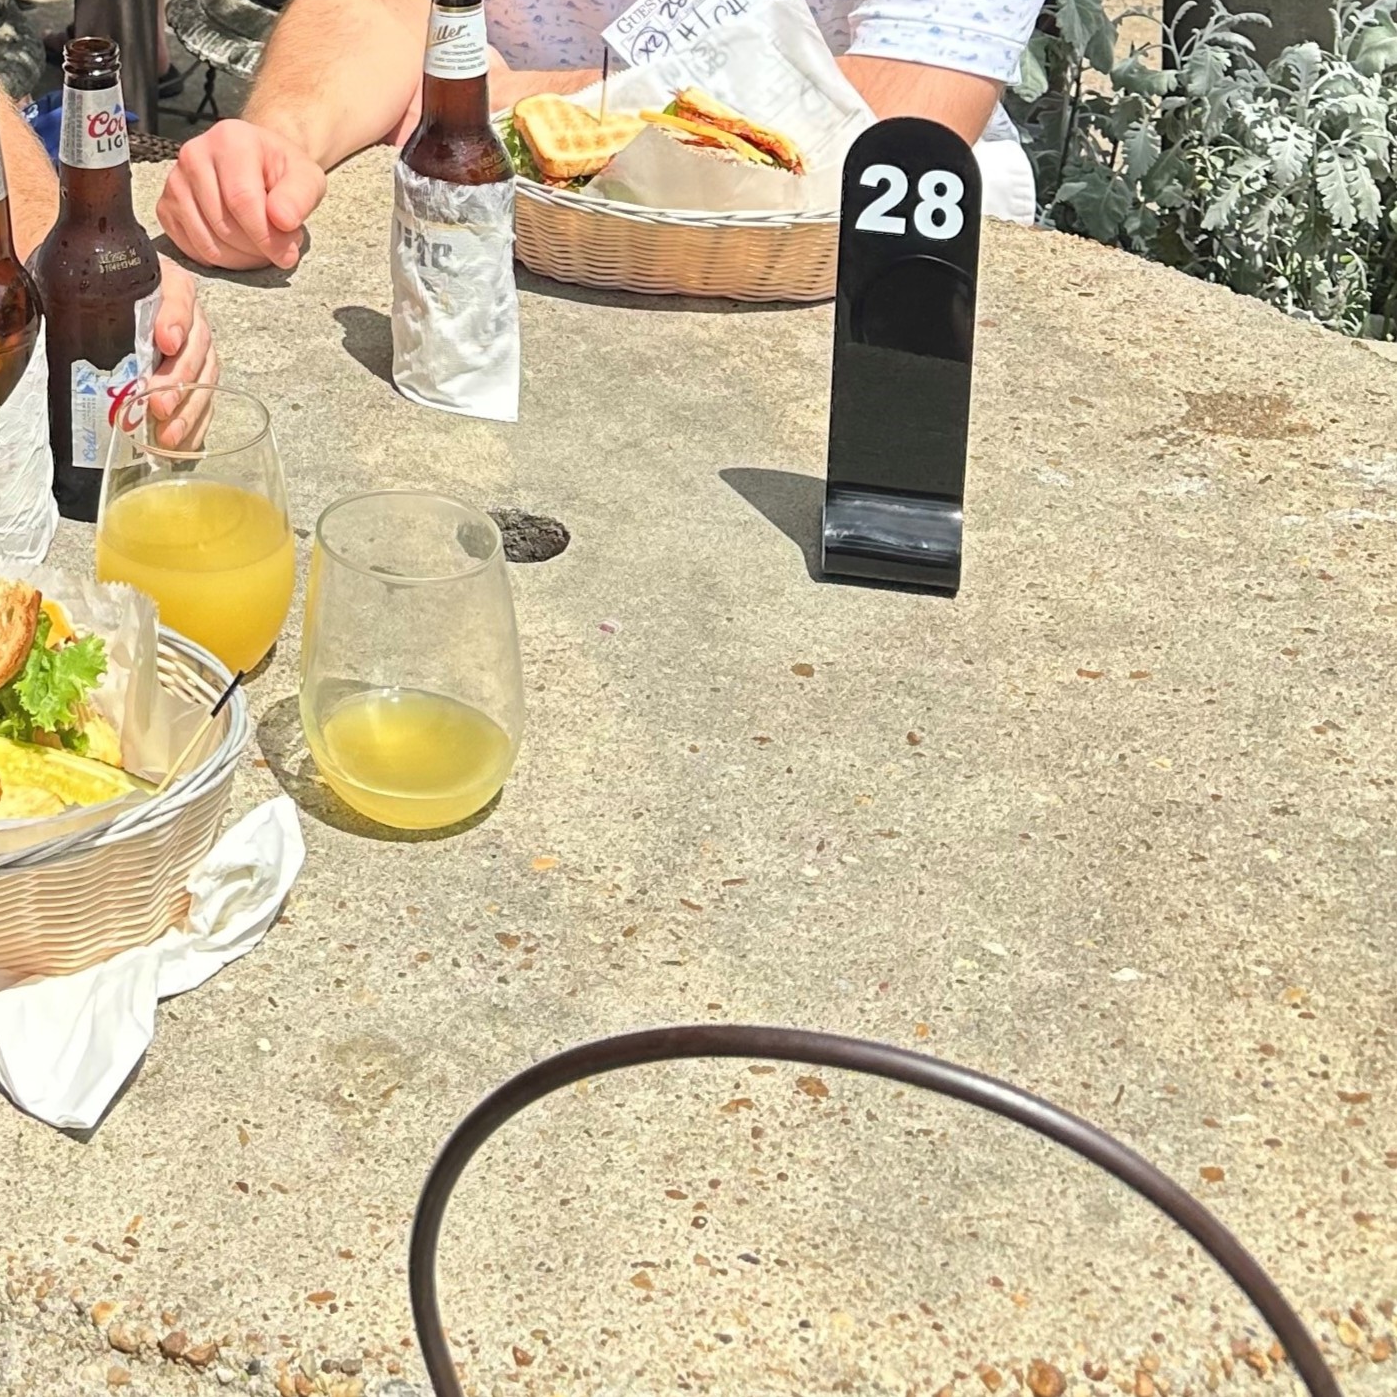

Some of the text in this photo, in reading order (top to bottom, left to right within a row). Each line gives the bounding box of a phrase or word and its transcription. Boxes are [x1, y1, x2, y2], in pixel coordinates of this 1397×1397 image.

[432, 23, 468, 41] iller
[97, 133, 126, 153] LIG
[854, 164, 965, 240] 28
